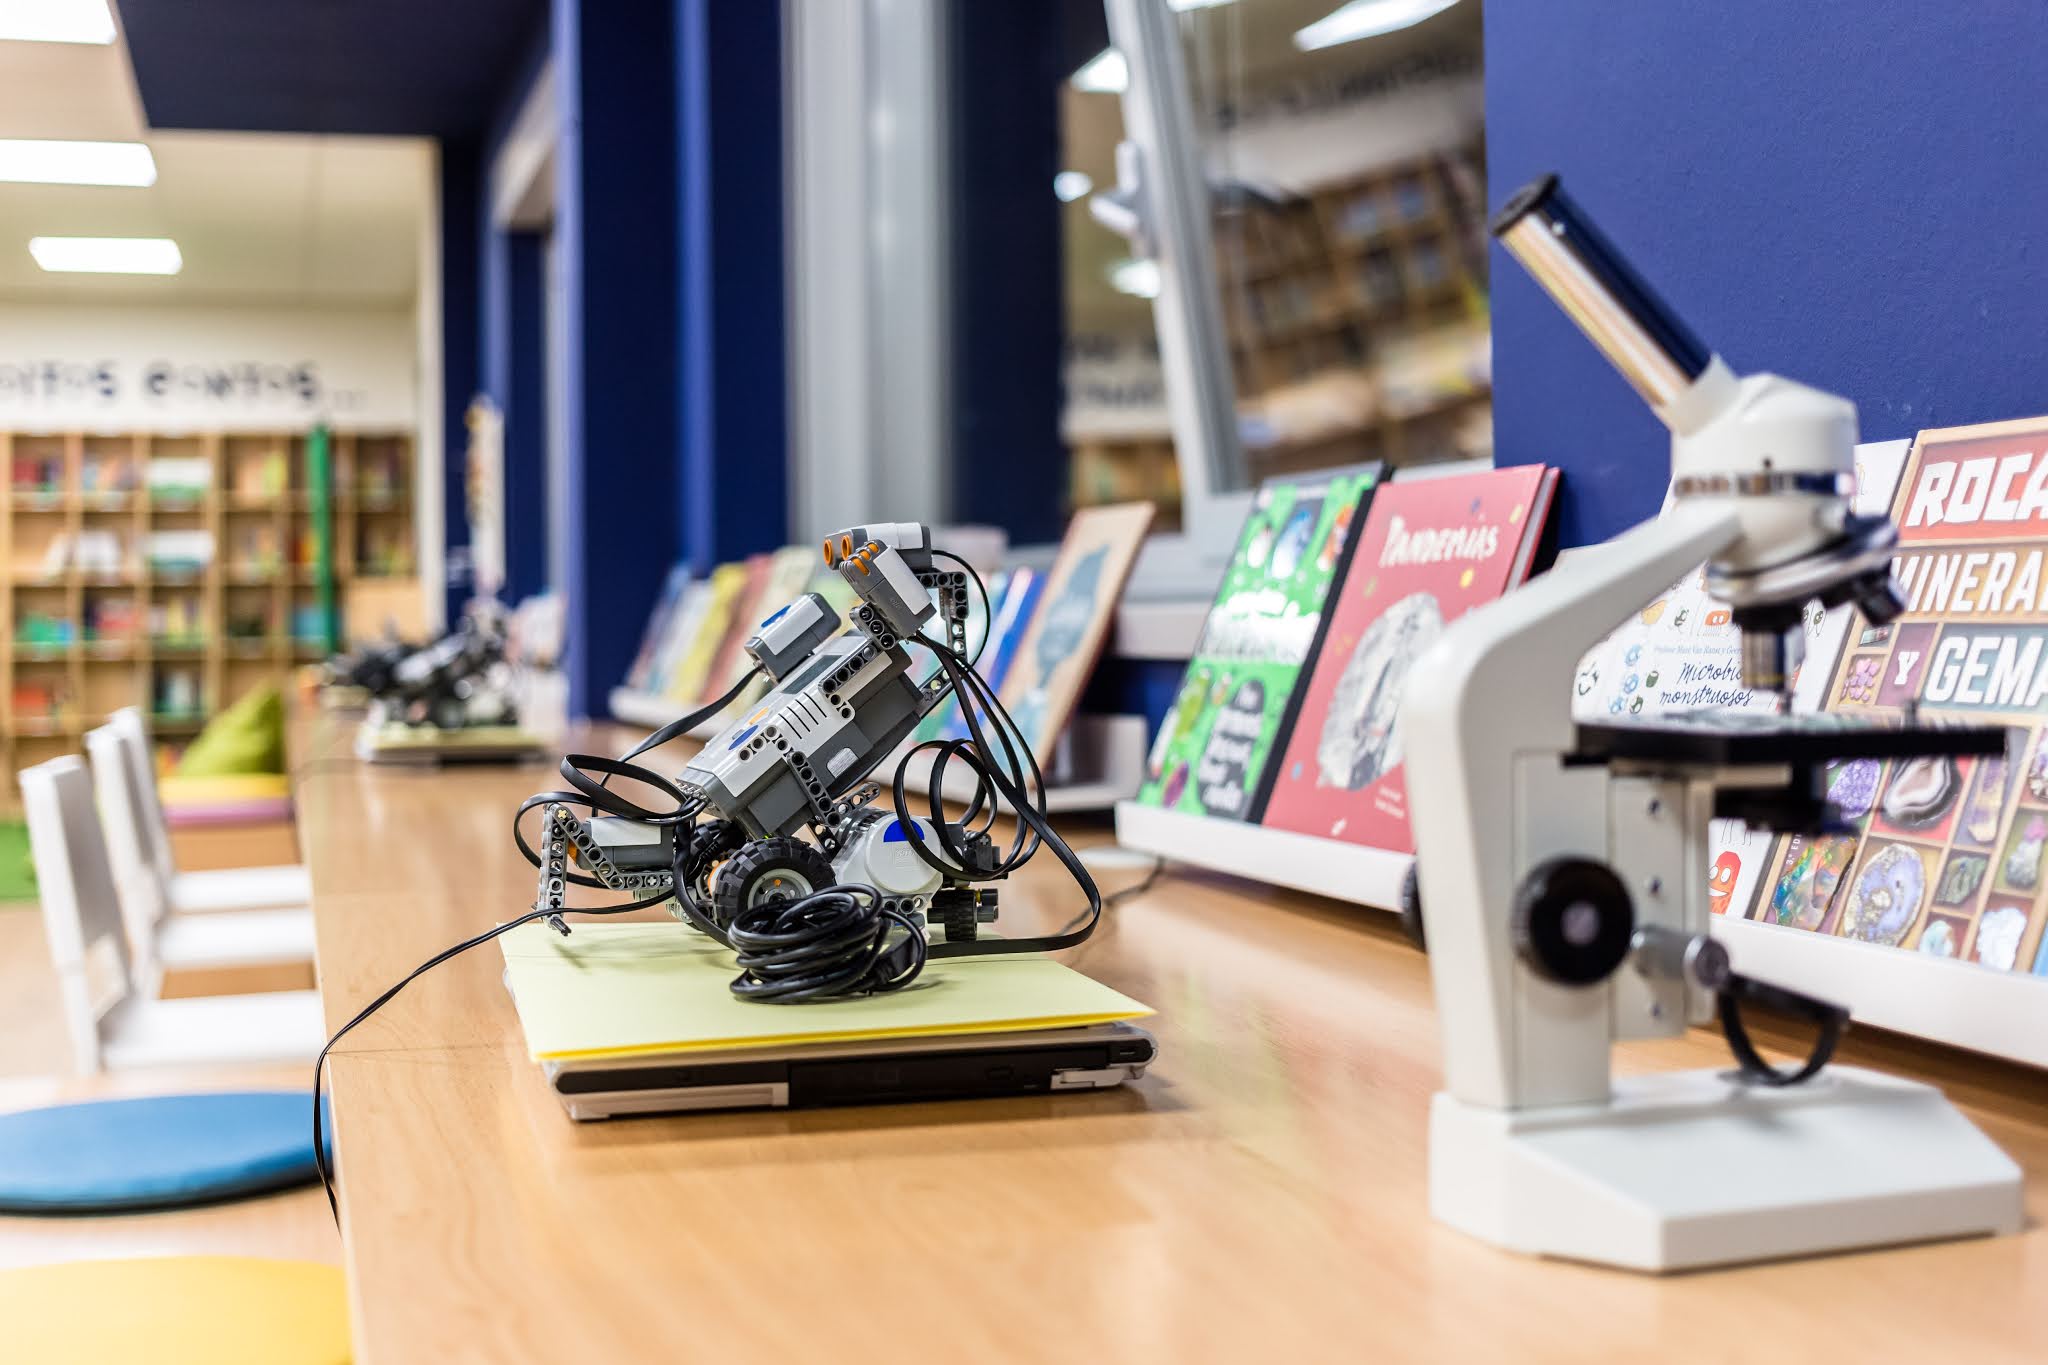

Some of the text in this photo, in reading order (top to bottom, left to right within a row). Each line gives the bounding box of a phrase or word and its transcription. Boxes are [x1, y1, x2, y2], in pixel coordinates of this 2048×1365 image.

[1889, 551, 2048, 612] MINERA
[1676, 658, 1743, 684] Microbio
[1894, 651, 1920, 685] Y
[1659, 684, 1753, 707] monstruosos
